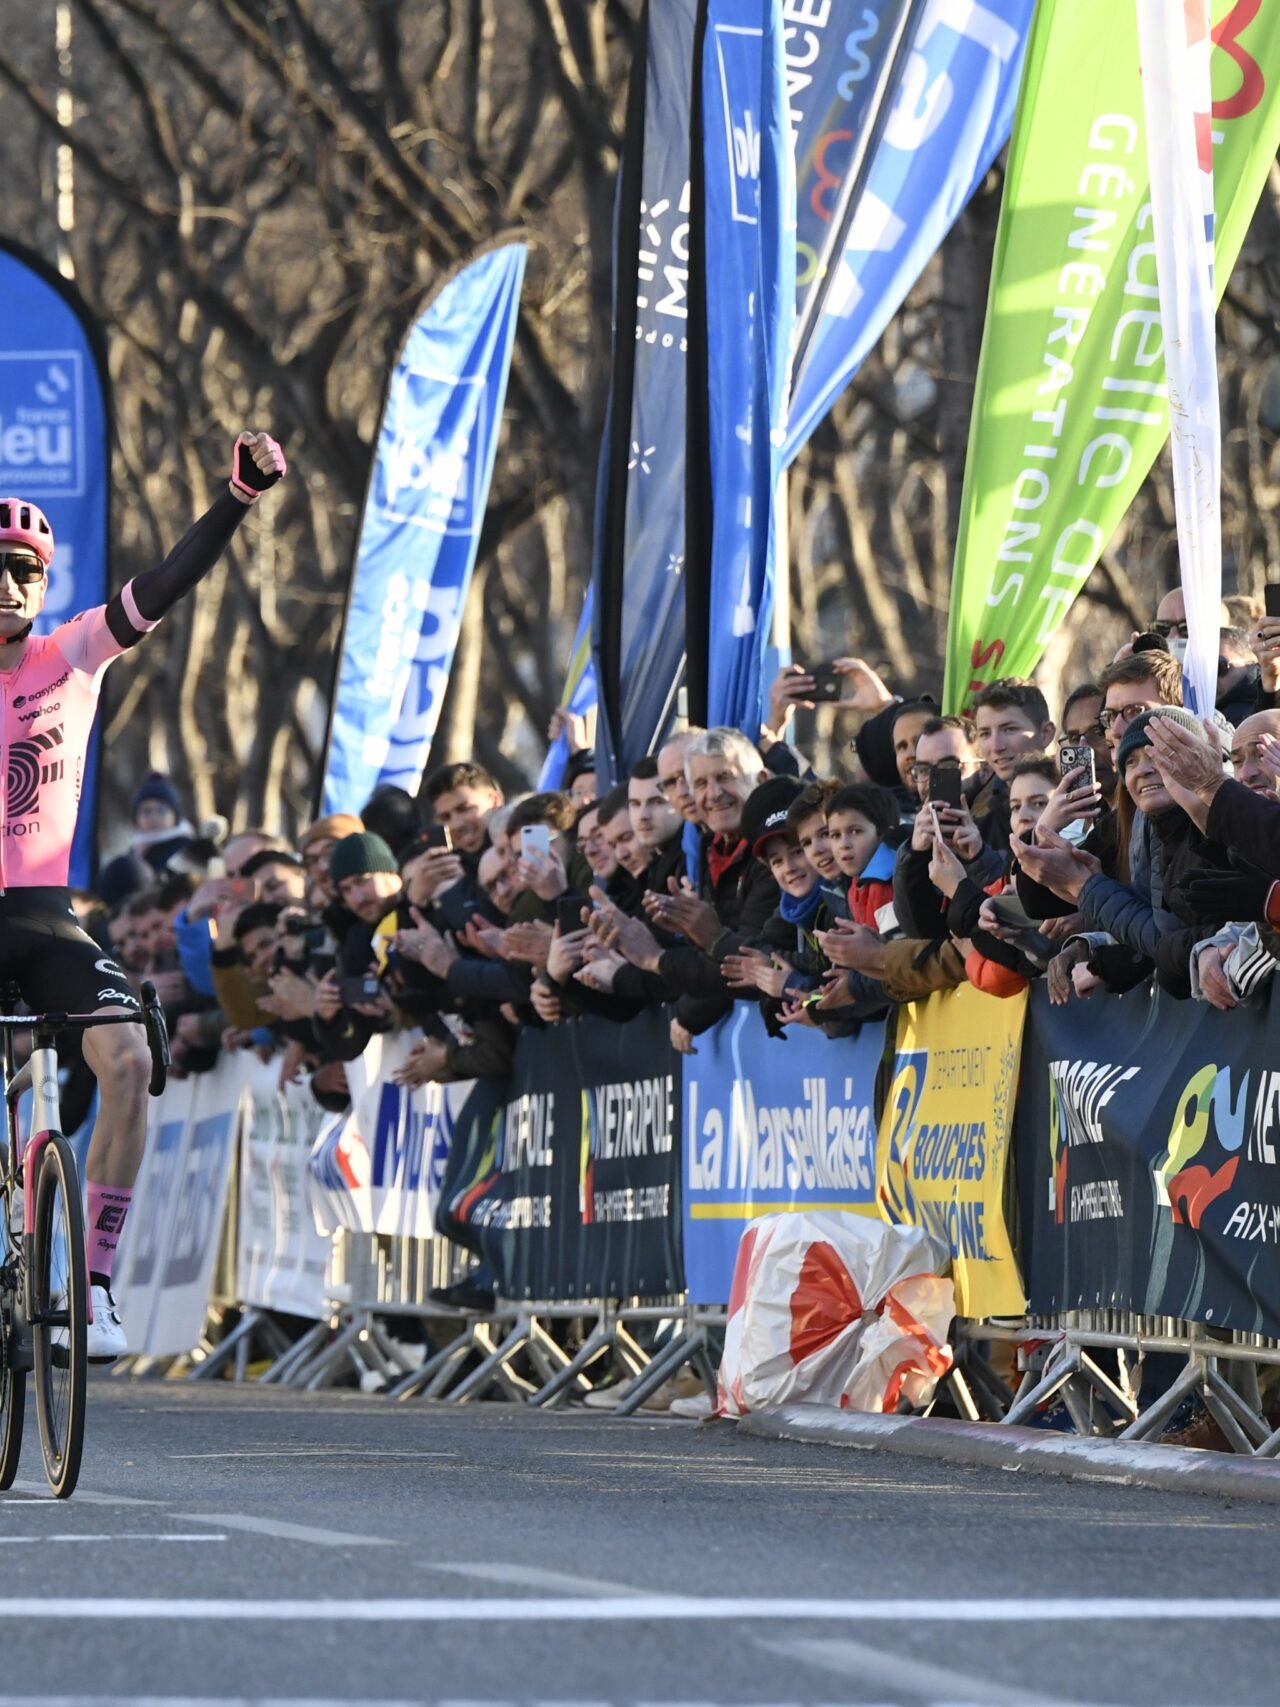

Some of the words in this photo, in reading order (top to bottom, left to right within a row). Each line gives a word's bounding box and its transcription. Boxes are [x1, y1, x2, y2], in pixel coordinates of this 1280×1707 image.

[986, 112, 1138, 607] GÉNÉRATIONS
[18, 702, 61, 722] wahoo
[28, 671, 69, 702] easypost
[689, 1081, 723, 1191] La
[727, 1077, 870, 1190] Marseillaise
[913, 1121, 986, 1181] BOUCHES
